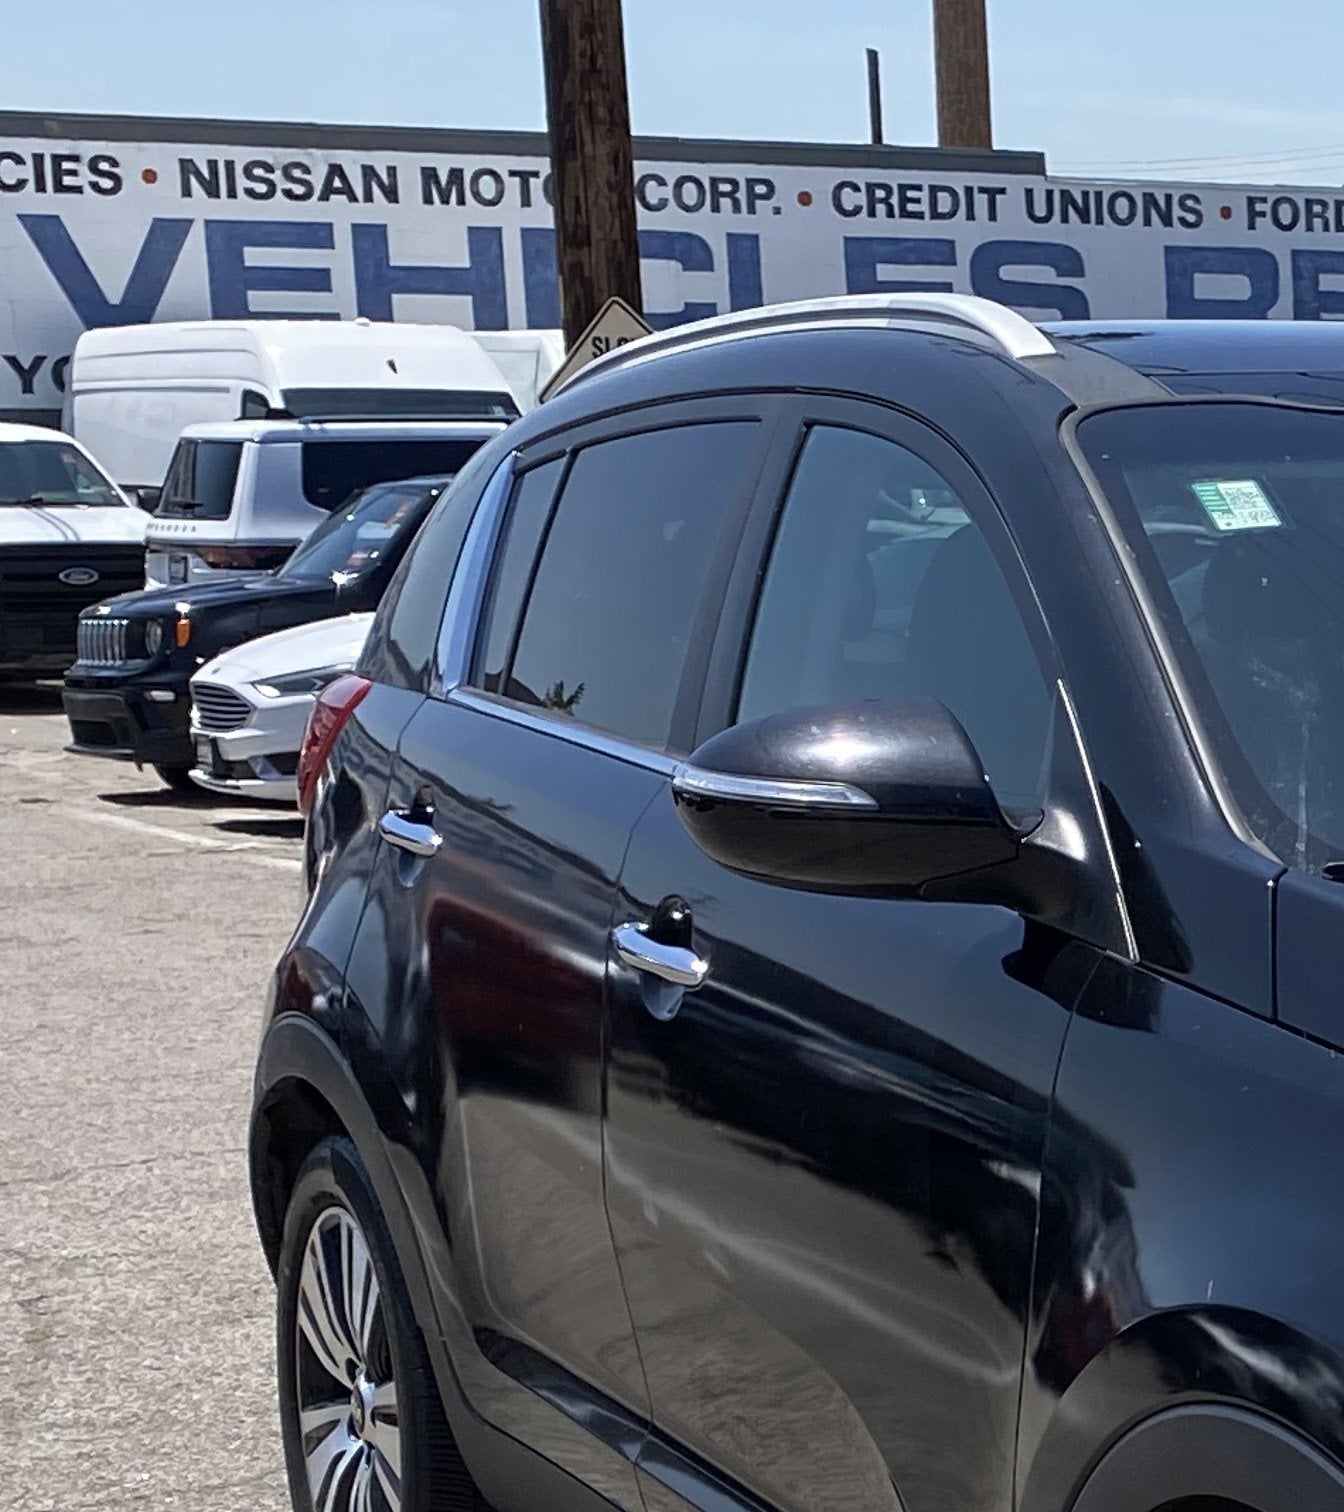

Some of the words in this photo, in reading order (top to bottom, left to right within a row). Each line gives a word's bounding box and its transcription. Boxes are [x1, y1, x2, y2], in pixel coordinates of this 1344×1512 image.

[178, 158, 400, 204] NISSAN
[420, 166, 557, 208] MOT
[635, 173, 781, 216] CORP.
[830, 180, 1006, 223] CREDIT
[1024, 187, 1204, 229] UNIONS
